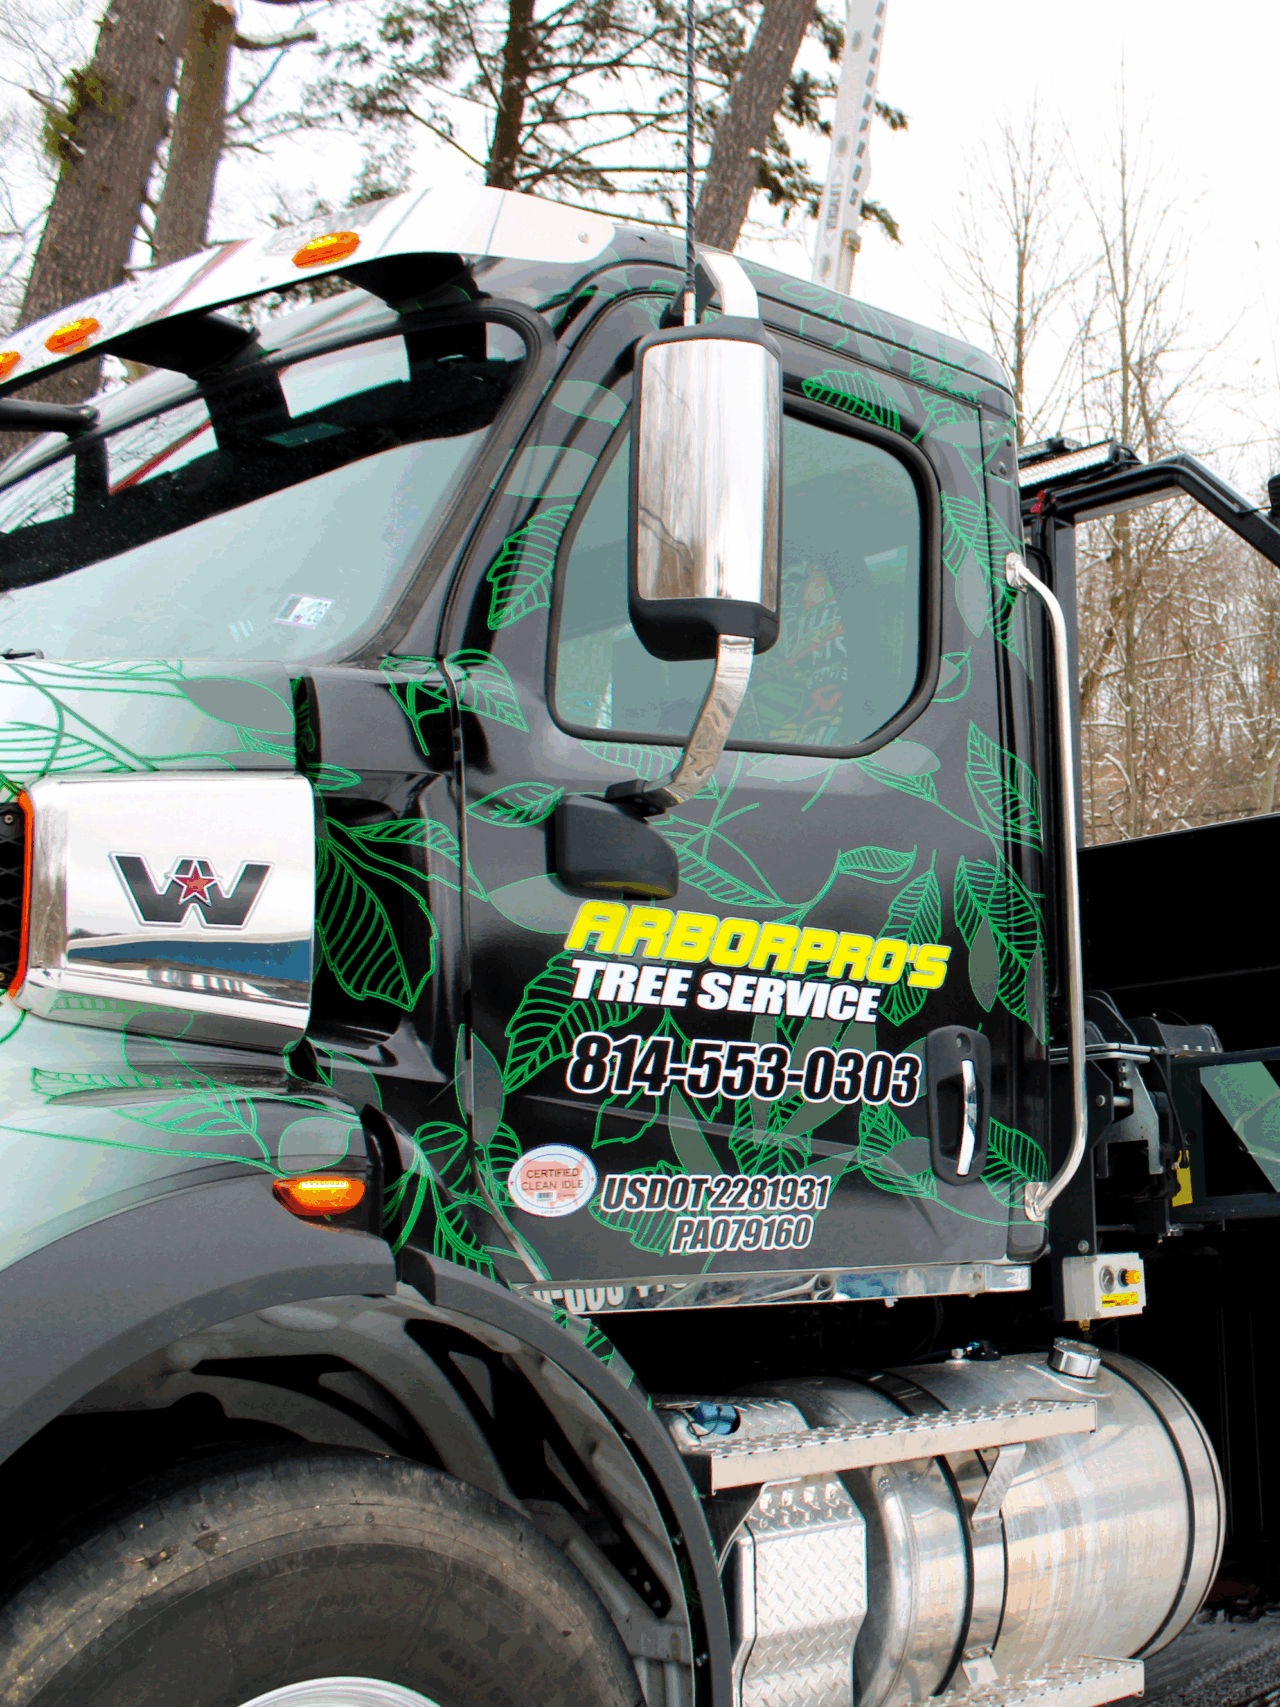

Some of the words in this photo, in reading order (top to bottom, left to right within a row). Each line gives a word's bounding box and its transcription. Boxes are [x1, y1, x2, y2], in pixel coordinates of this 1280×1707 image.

[564, 900, 951, 989] ARBORPRO'S
[570, 959, 693, 1007] TREE
[696, 970, 883, 1023] SERVICE
[565, 1031, 922, 1105] 814-553-0303
[521, 1181, 557, 1191] CLEAN
[562, 1179, 584, 1189] IDLE
[526, 1167, 580, 1179] CERTIFIED
[600, 1174, 709, 1212] USDOT
[707, 1175, 831, 1210] 2281931
